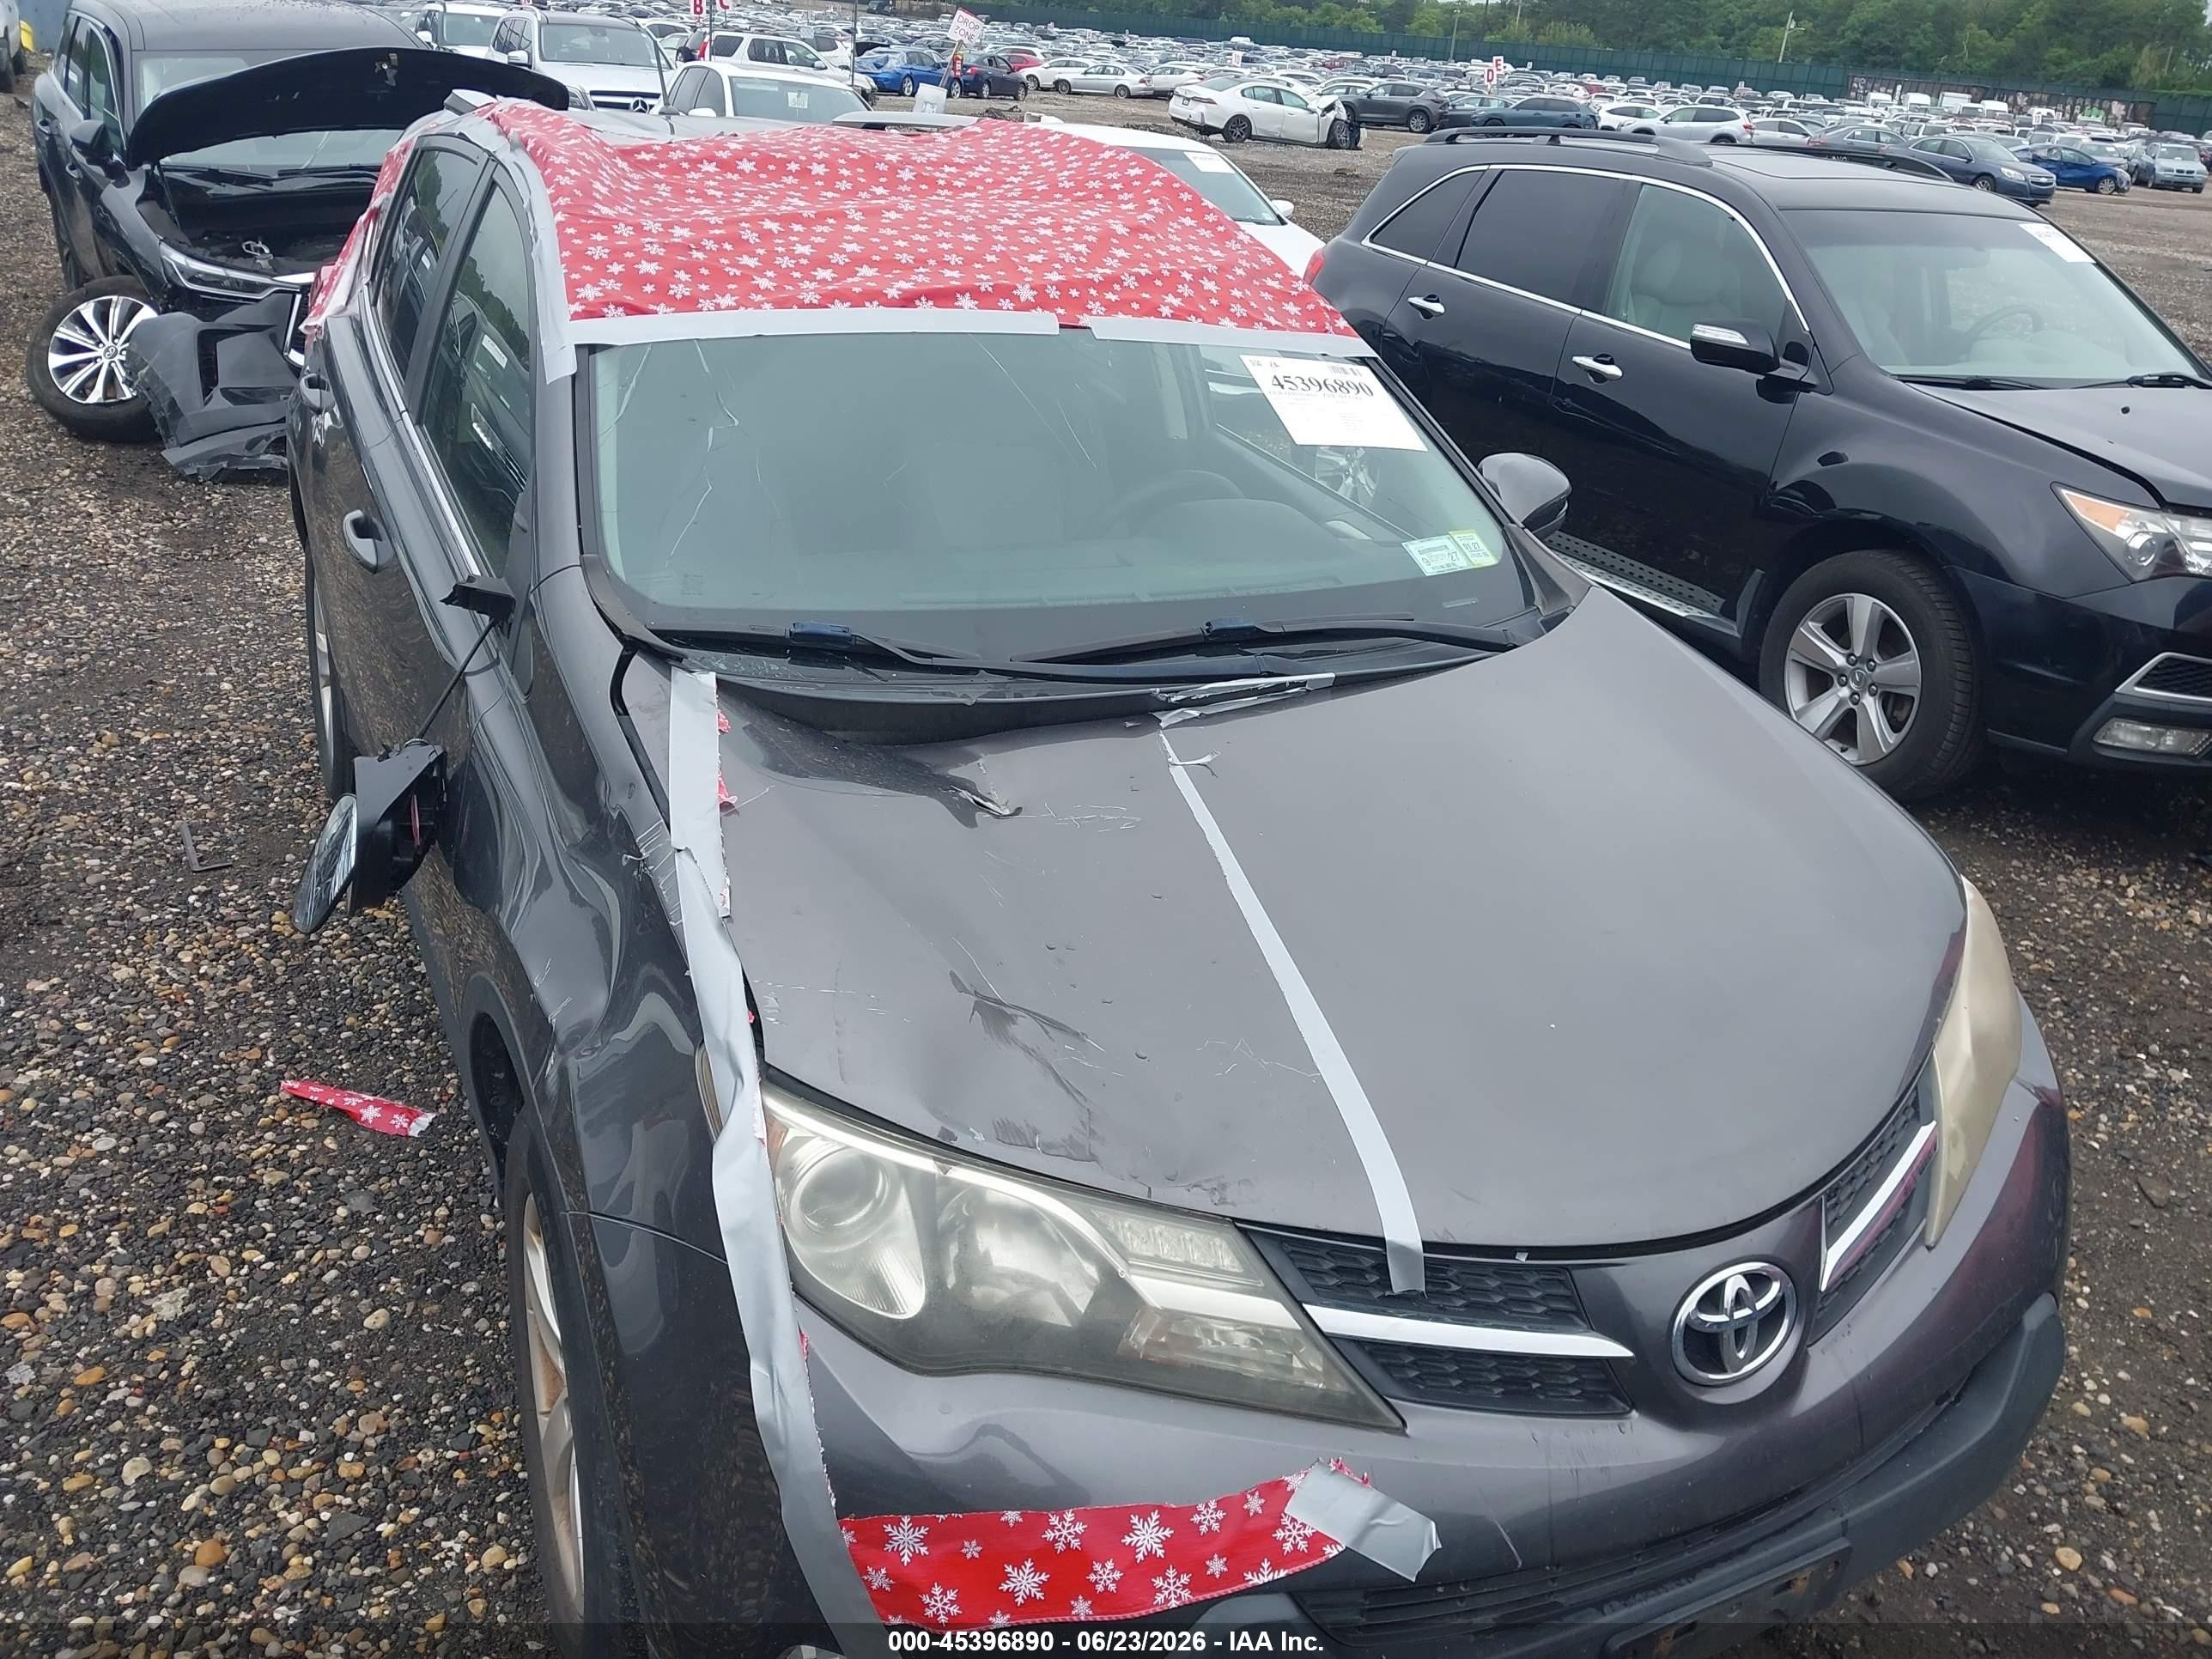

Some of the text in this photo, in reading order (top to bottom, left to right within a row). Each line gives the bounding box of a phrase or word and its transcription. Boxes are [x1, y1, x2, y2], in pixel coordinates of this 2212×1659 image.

[693, 0, 703, 15] B
[957, 15, 980, 32] DROP
[954, 26, 975, 42] ZONE
[1495, 58, 1502, 71] E
[1486, 68, 1494, 82] D
[1272, 374, 1374, 397] 45396890
